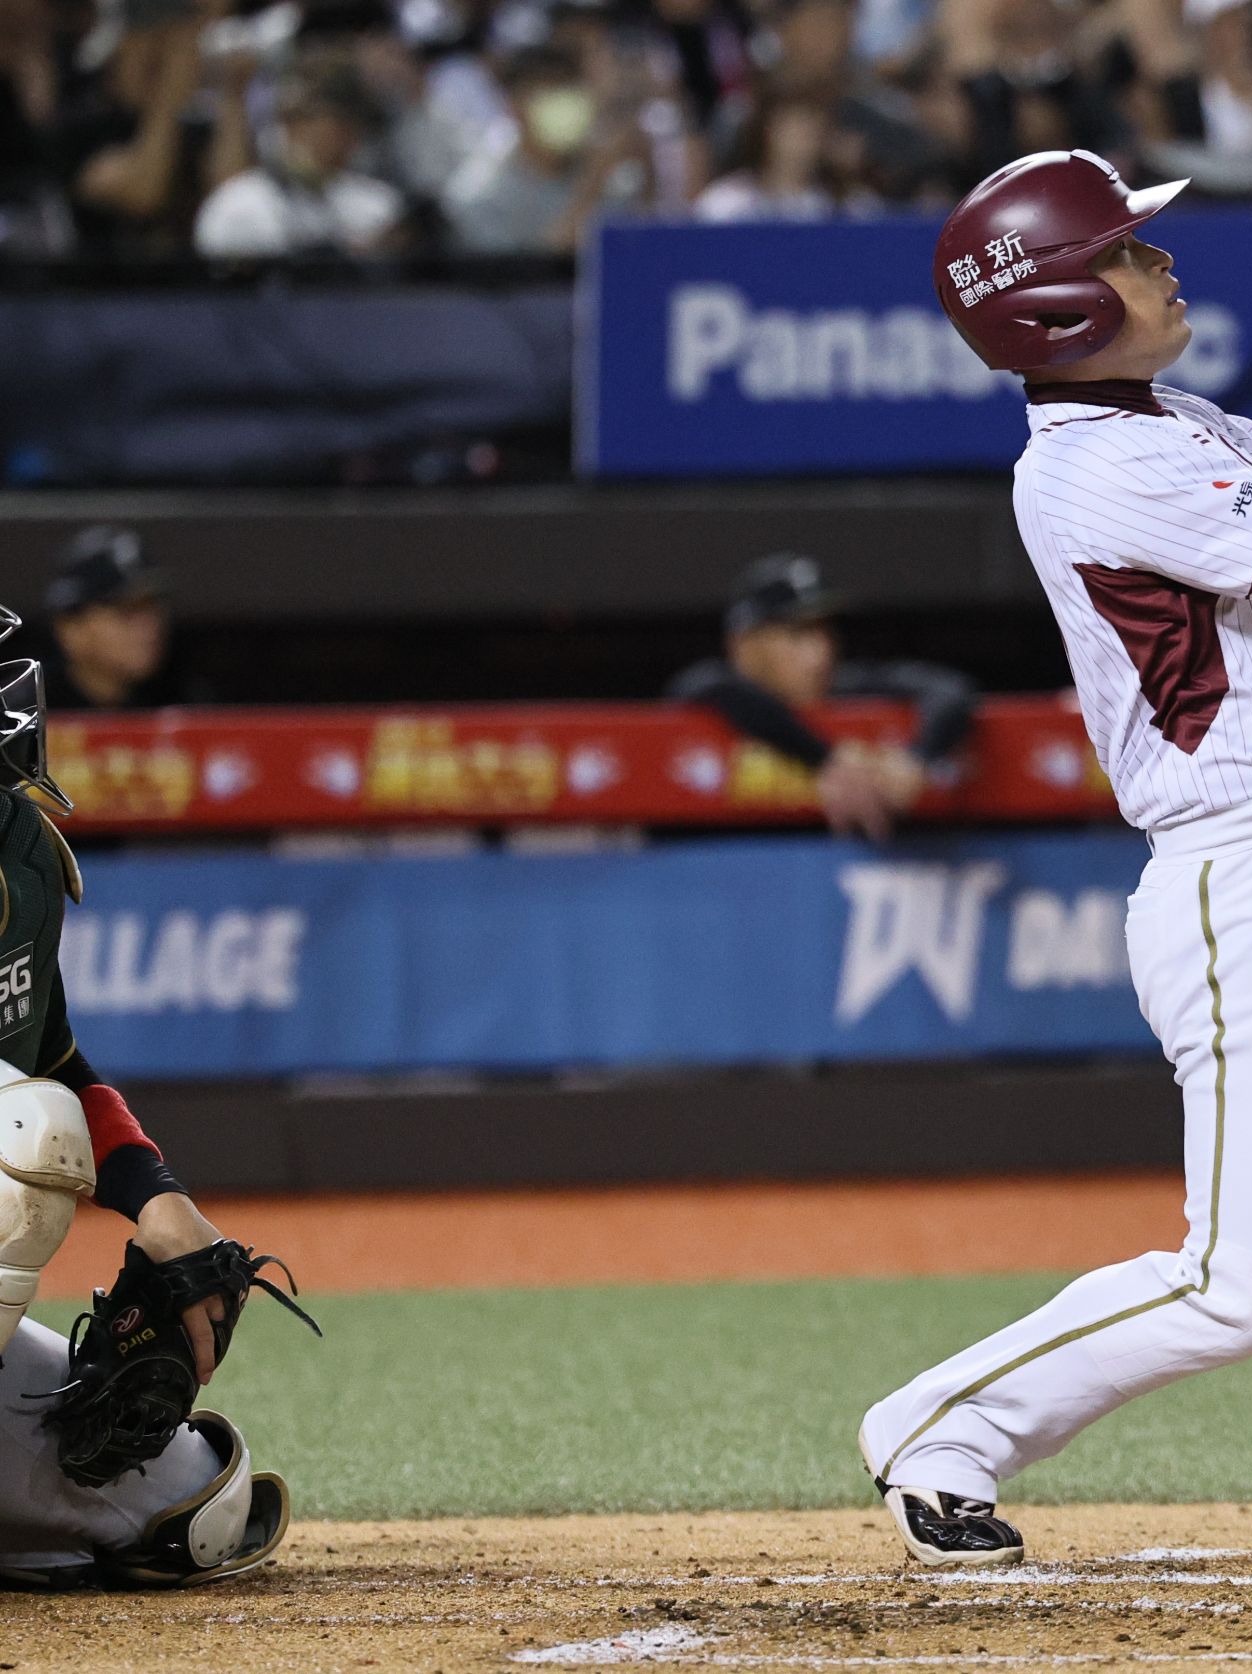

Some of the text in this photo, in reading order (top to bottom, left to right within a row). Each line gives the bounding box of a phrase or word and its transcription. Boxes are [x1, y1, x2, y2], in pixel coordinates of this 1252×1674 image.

[947, 229, 1024, 288] 聯新
[959, 259, 1037, 307] 國際醫院
[0, 996, 30, 1028] 集團
[118, 1327, 156, 1357] Bird
